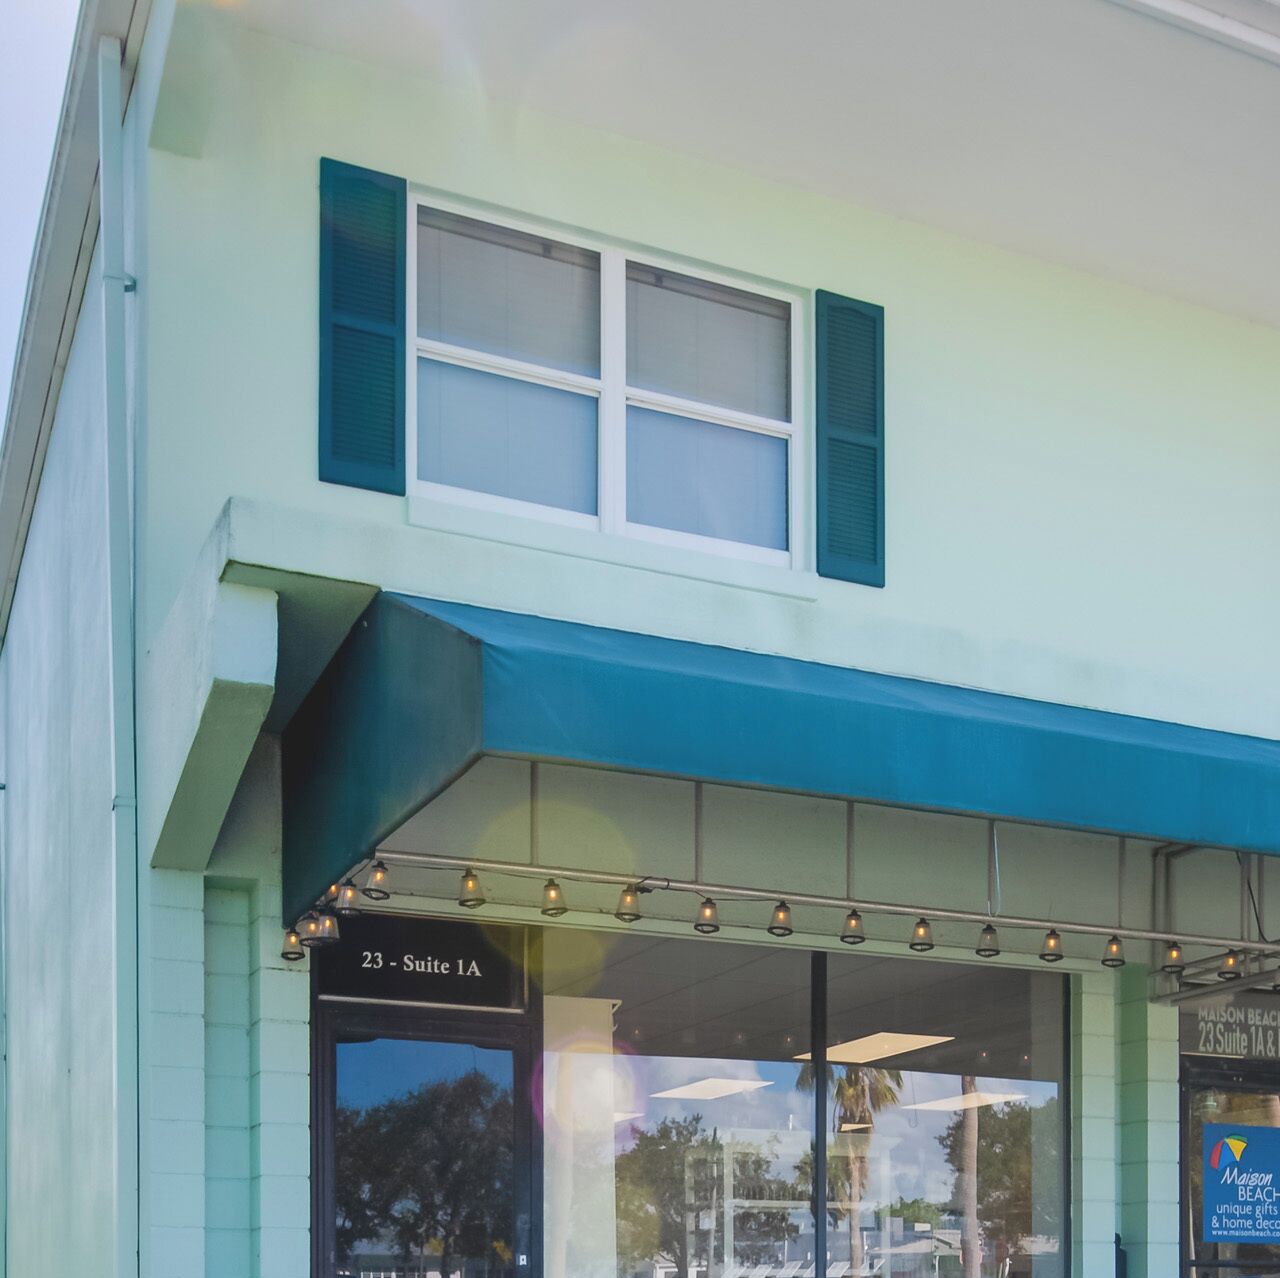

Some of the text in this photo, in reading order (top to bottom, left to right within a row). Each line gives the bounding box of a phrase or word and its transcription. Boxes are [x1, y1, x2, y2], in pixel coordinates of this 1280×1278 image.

[362, 951, 383, 969] 23
[403, 954, 450, 974] Suite
[456, 959, 483, 977] 1A
[1198, 1006, 1245, 1024] MAISON
[1198, 1021, 1214, 1052] 23
[1215, 1023, 1248, 1055] Suite
[1250, 1026, 1265, 1056] 1A
[1266, 1030, 1276, 1057] &
[1220, 1167, 1273, 1186] Maison
[1216, 1202, 1278, 1218] unique gifts
[1212, 1215, 1219, 1228] &
[1223, 1215, 1252, 1229] home
